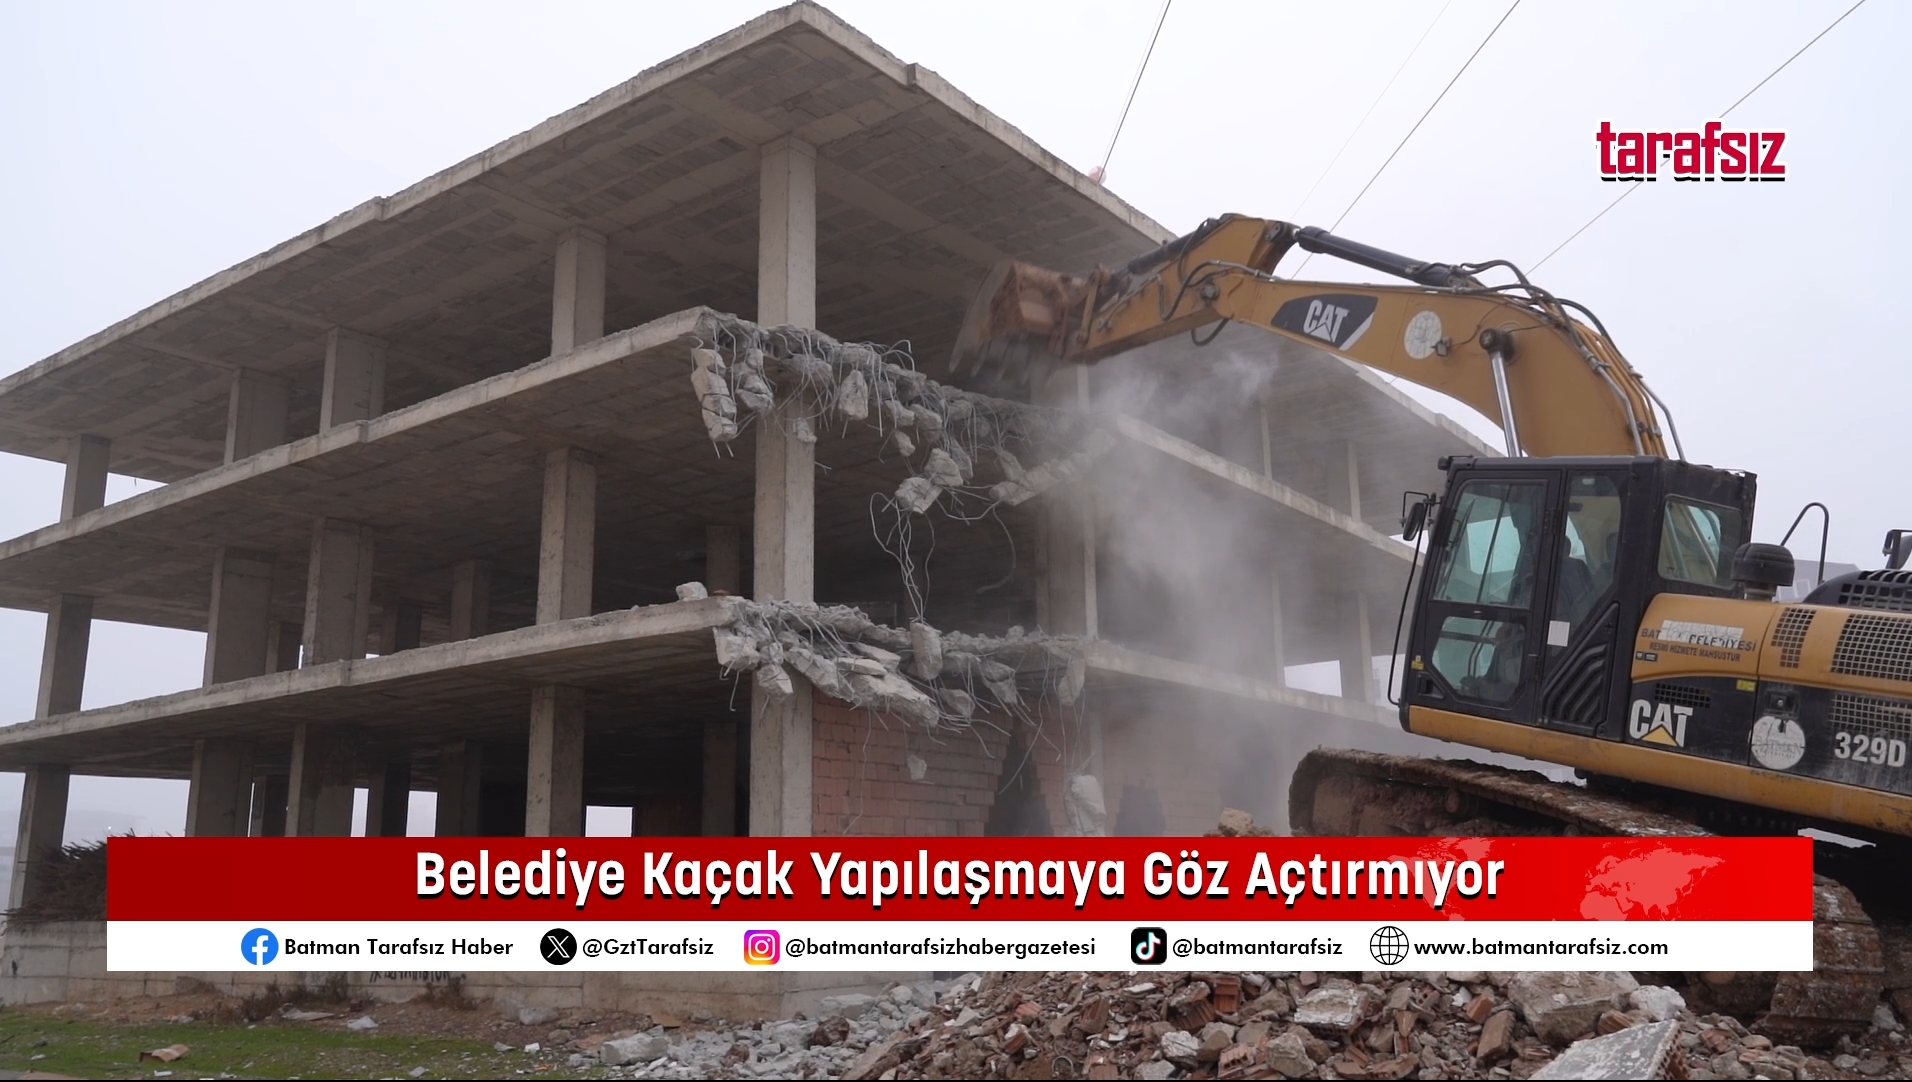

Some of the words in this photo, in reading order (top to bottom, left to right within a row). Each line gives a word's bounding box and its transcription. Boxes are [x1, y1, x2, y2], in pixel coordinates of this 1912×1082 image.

[1303, 300, 1349, 343] CAT
[1629, 699, 1694, 748] CAT
[1834, 732, 1907, 768] 329D
